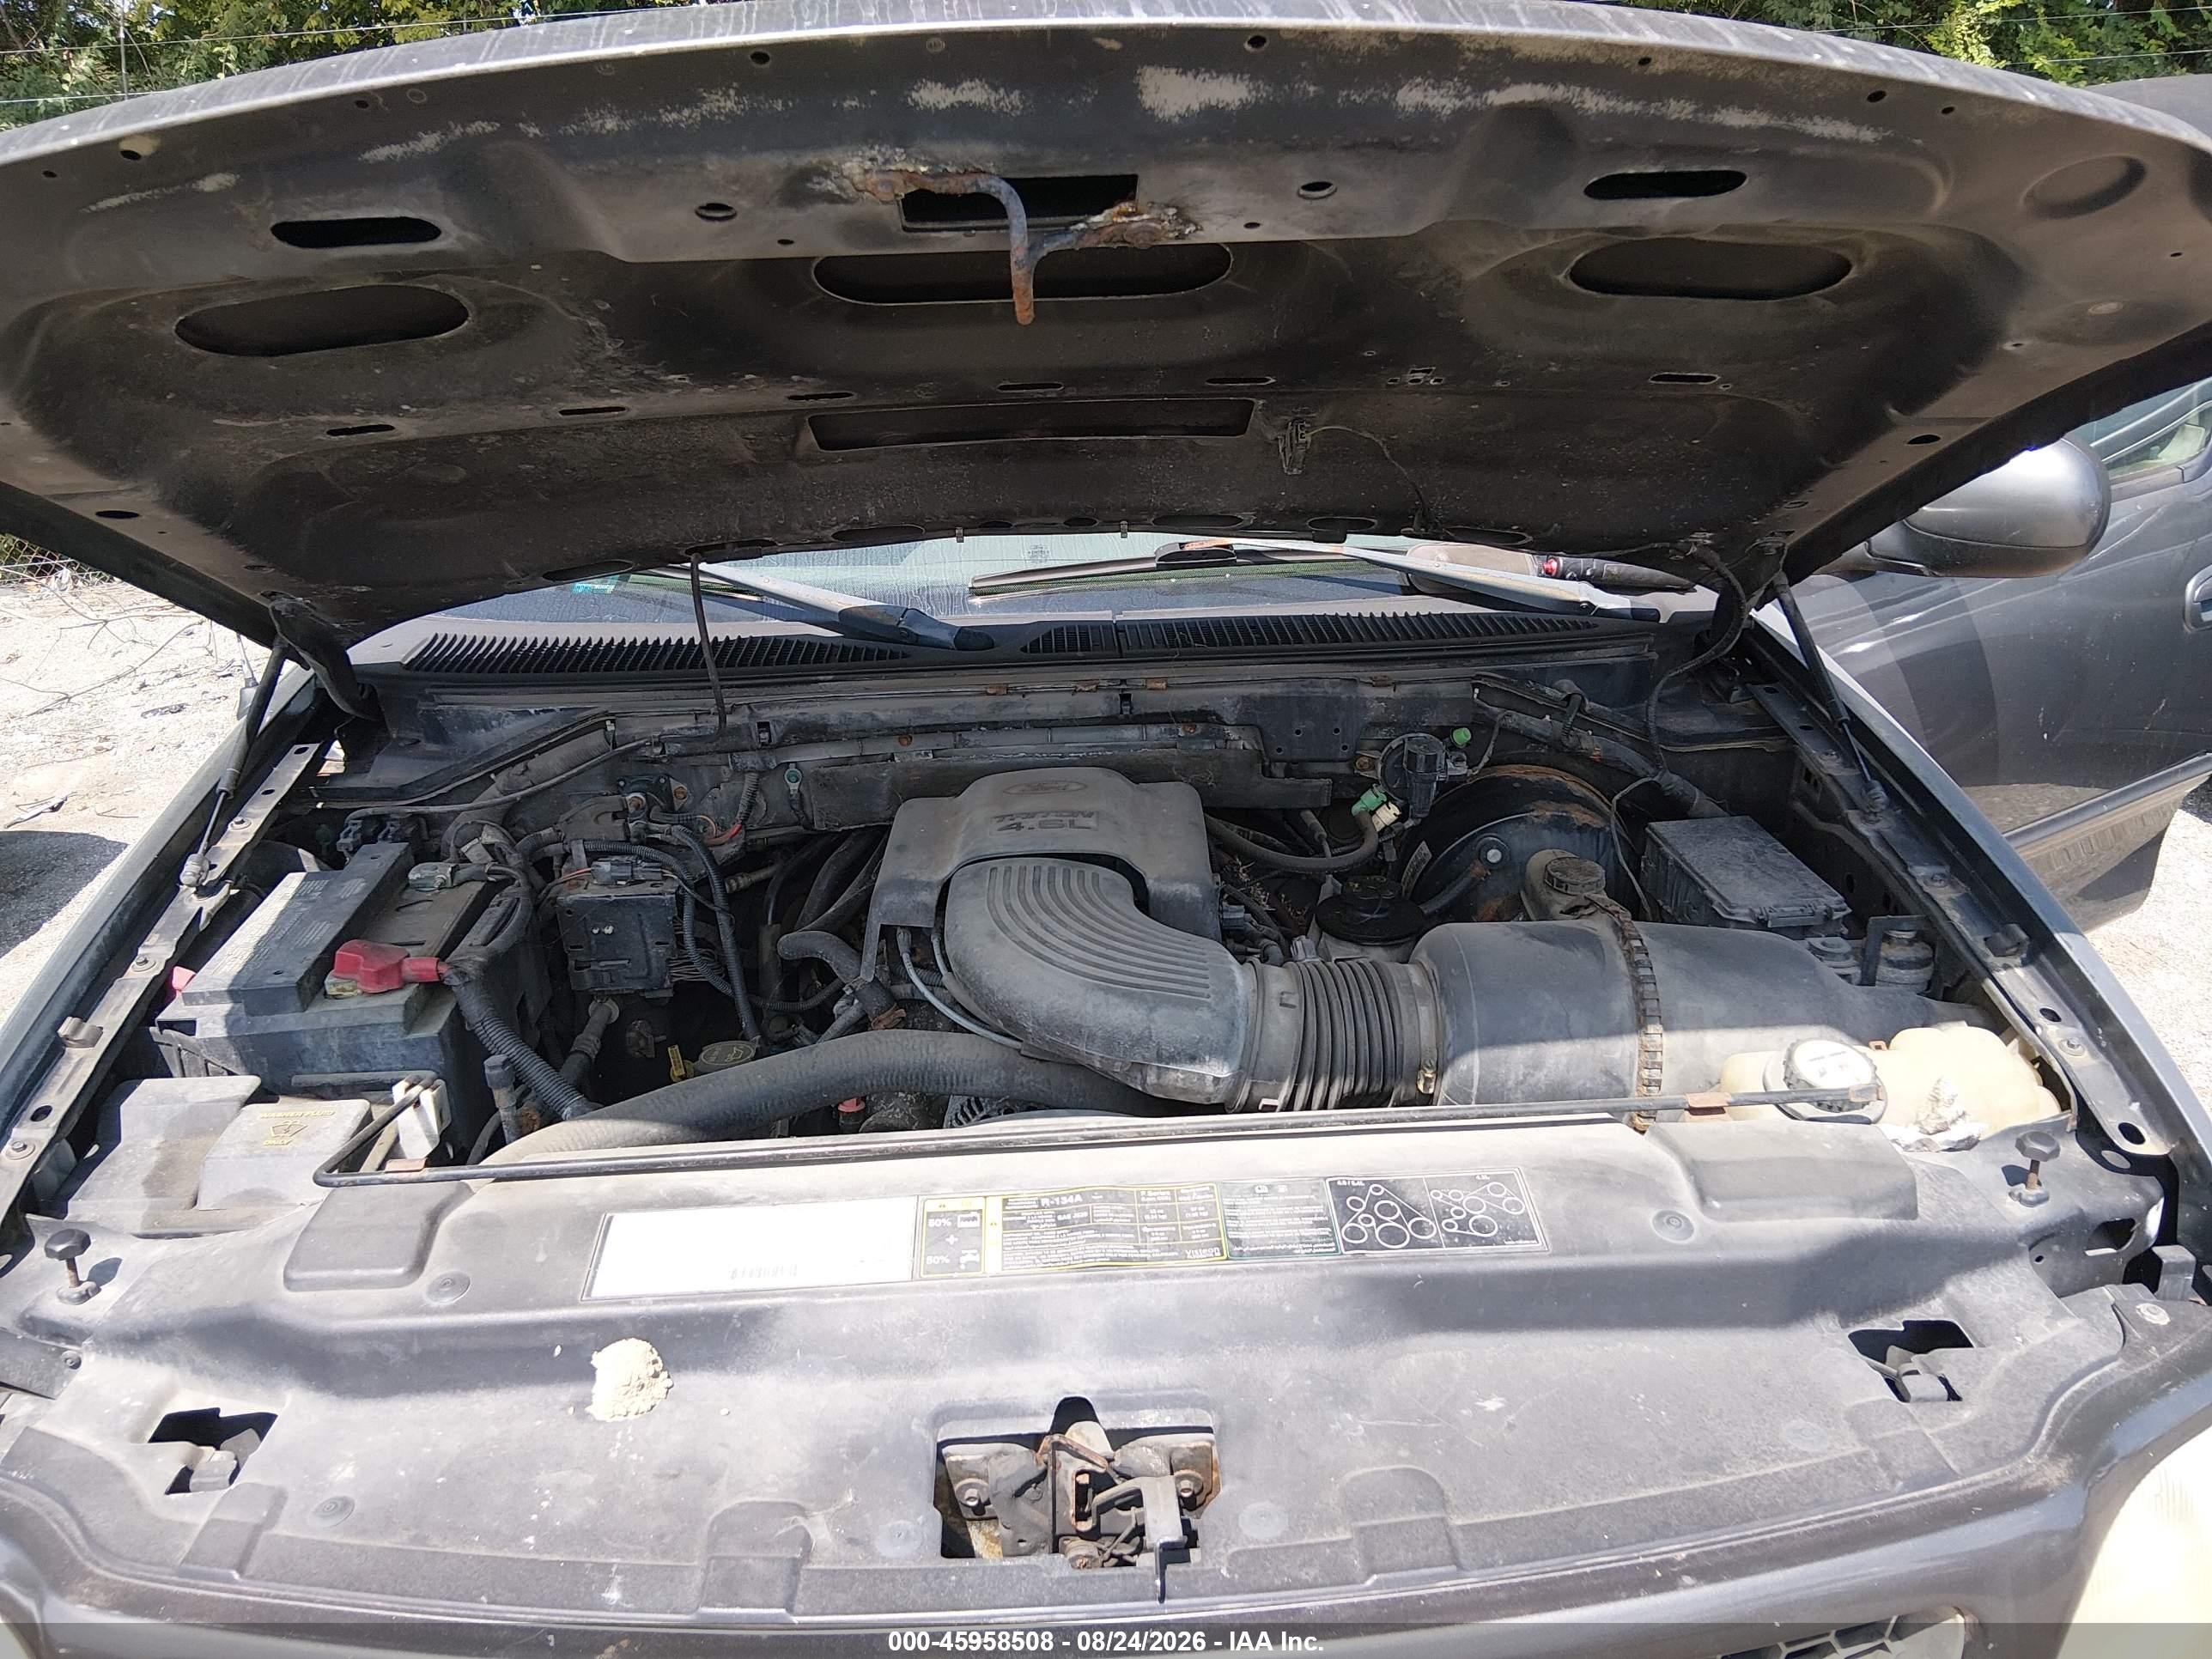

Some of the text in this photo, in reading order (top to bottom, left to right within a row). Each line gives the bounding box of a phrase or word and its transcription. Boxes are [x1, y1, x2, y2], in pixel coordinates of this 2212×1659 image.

[992, 811, 1096, 823] TRITON
[996, 818, 1091, 831] 4.6L
[1041, 1194, 1083, 1206] R-134A
[927, 1218, 951, 1228] 50%
[926, 1255, 951, 1265] 50%
